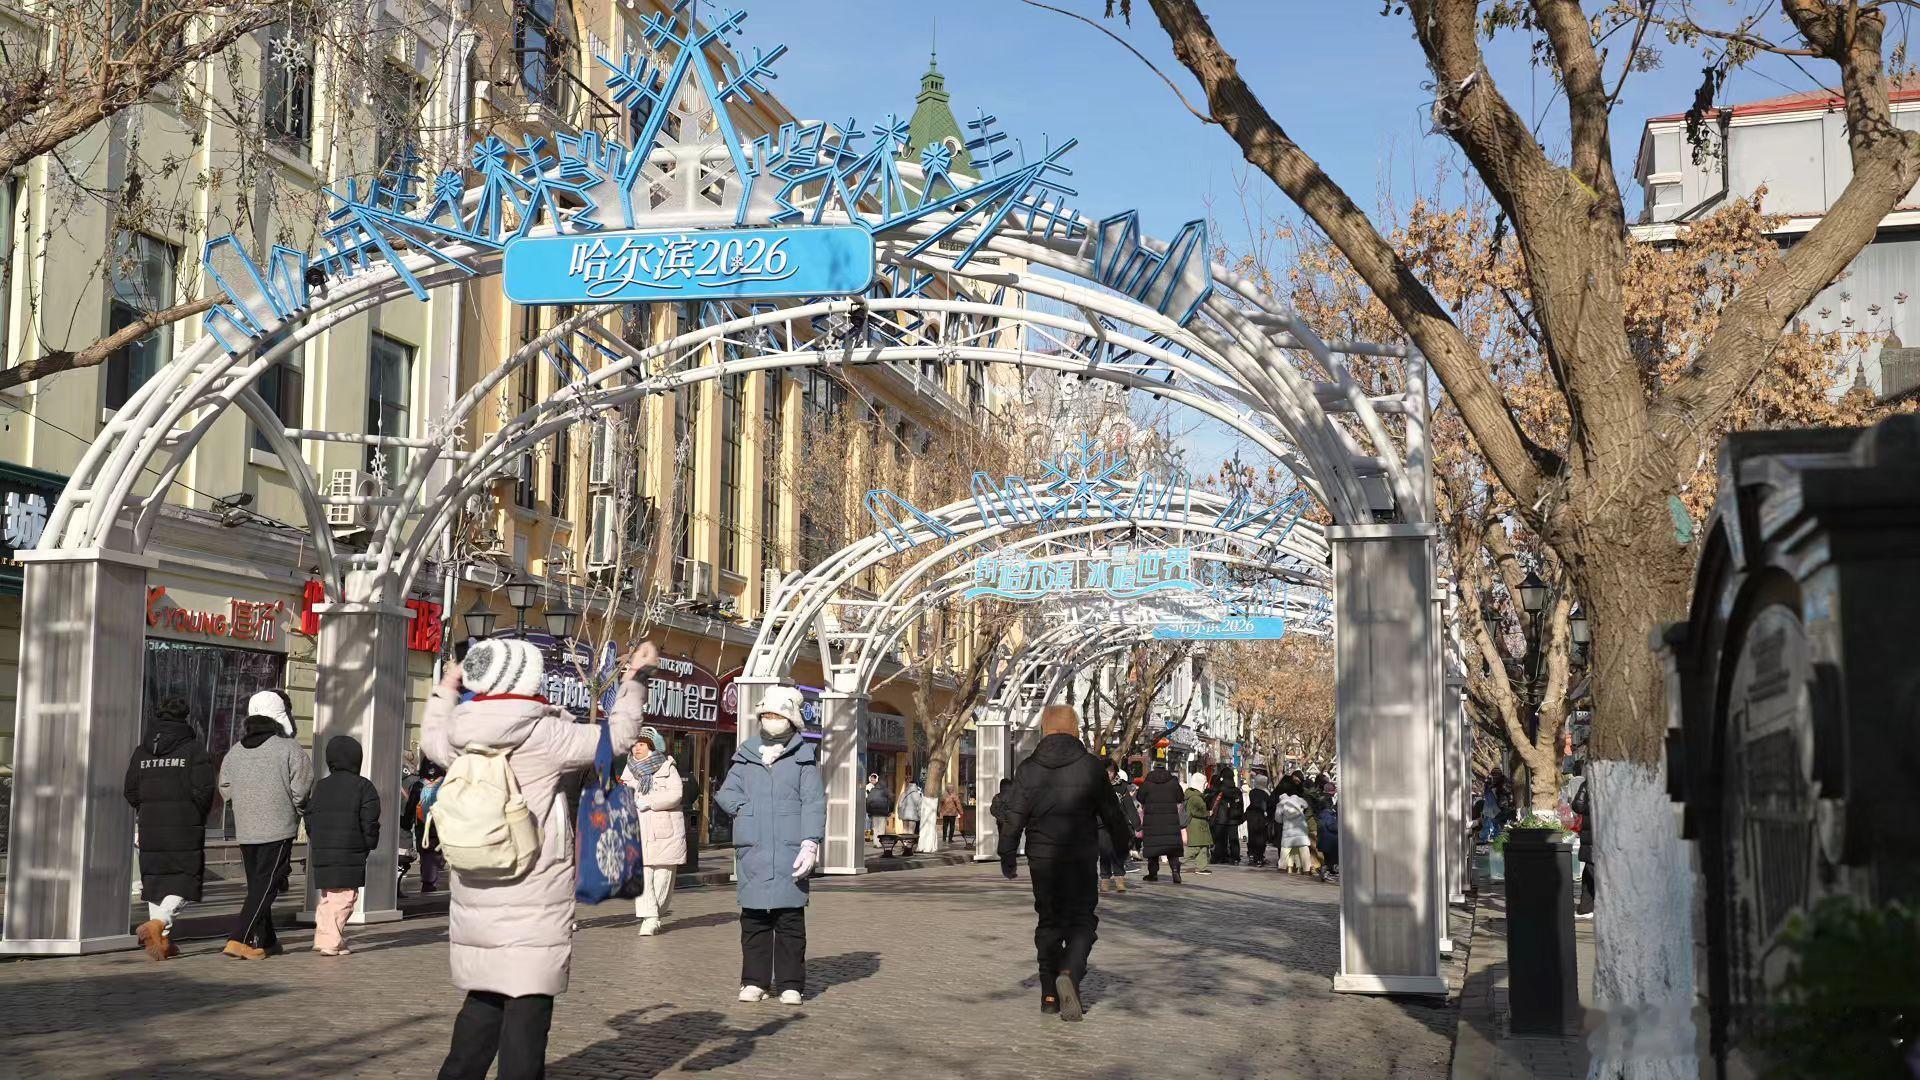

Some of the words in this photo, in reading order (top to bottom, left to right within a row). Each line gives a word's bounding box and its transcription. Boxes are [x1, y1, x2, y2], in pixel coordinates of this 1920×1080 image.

[568, 235, 799, 298] 哈尔滨2026
[647, 677, 718, 722] 秋林食品
[140, 758, 186, 769] EXTREME
